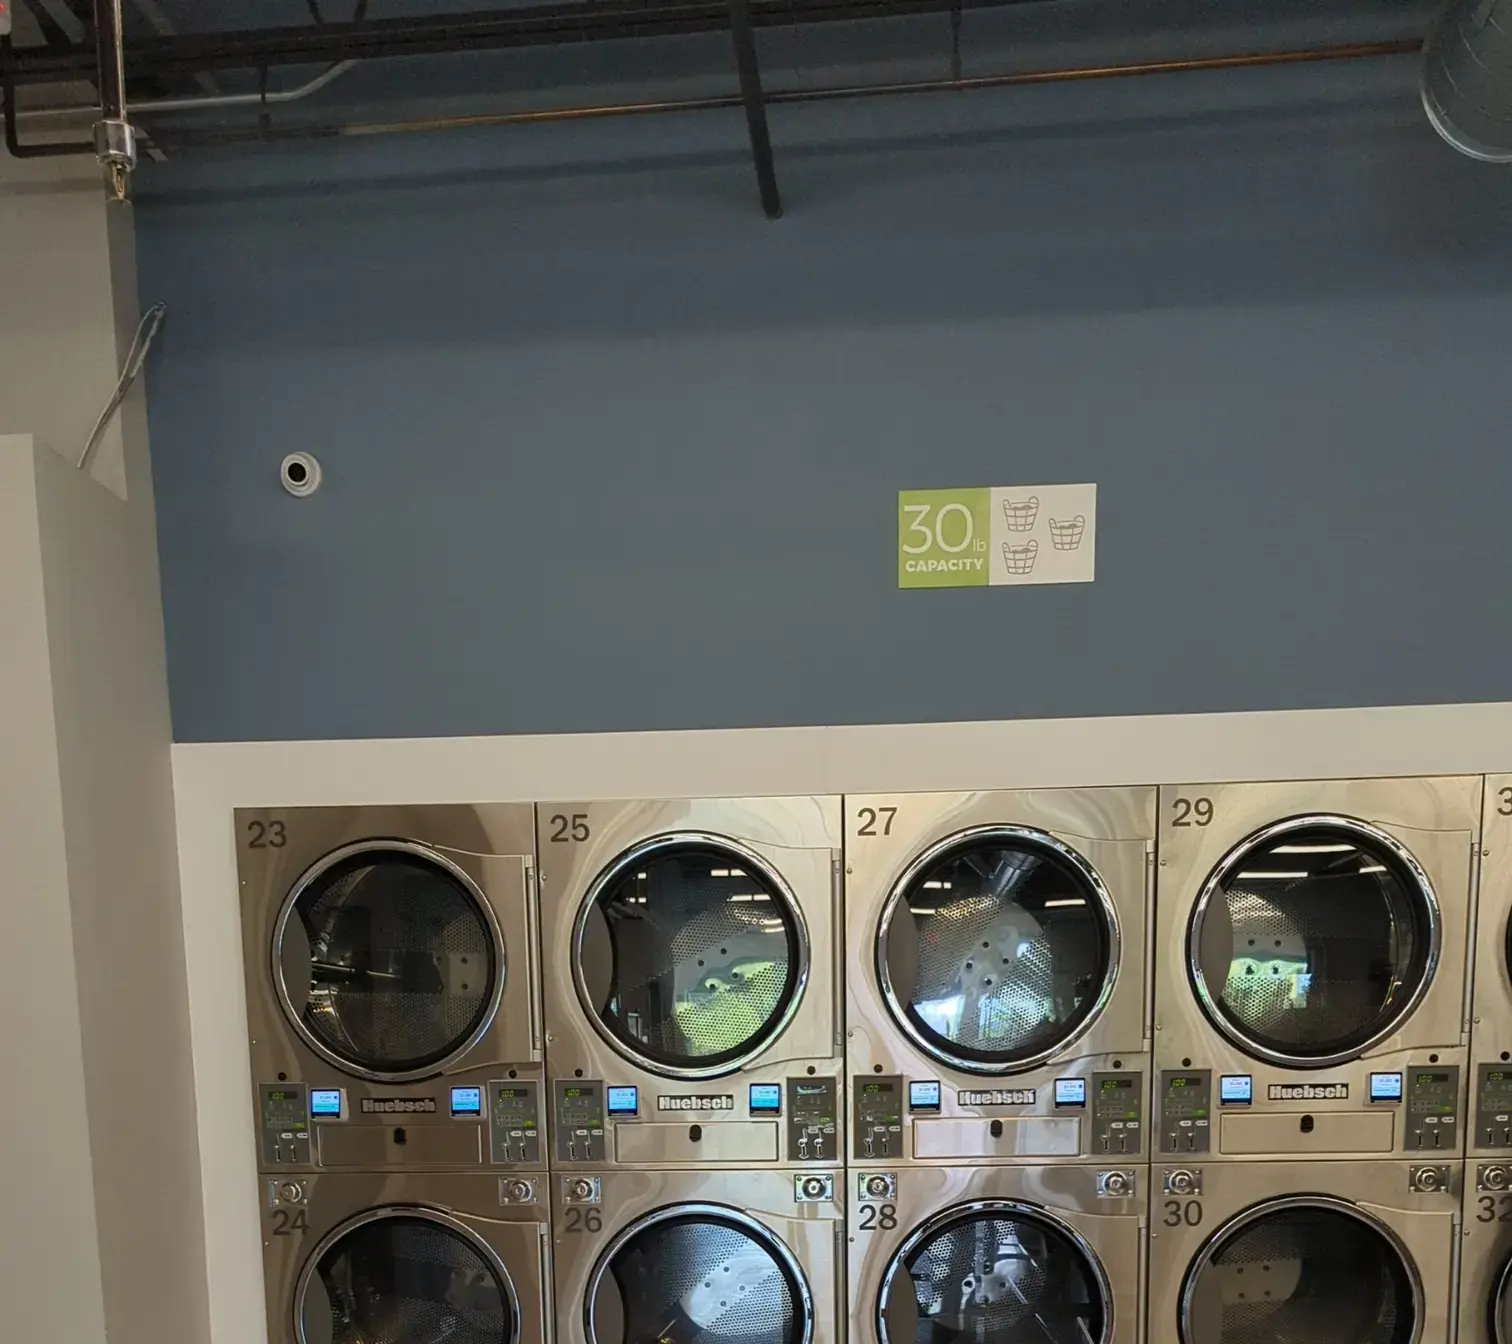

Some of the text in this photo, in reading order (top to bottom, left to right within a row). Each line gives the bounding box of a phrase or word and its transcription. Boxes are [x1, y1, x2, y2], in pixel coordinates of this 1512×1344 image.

[905, 558, 984, 572] CAPACITY
[1171, 798, 1214, 827] 29
[1496, 786, 1512, 816] 3
[247, 821, 287, 849] 23
[550, 814, 590, 843] 25
[857, 807, 898, 837] 27
[658, 1096, 733, 1110] Huebsch
[958, 1090, 1036, 1105] Huebsch
[1268, 1085, 1348, 1099] Huebsch
[361, 1098, 436, 1113] Huebsch
[271, 1209, 309, 1235] 24
[564, 1208, 603, 1233] 26
[858, 1204, 898, 1230] 28
[1162, 1201, 1203, 1227] 30
[1476, 1195, 1512, 1223] 32
